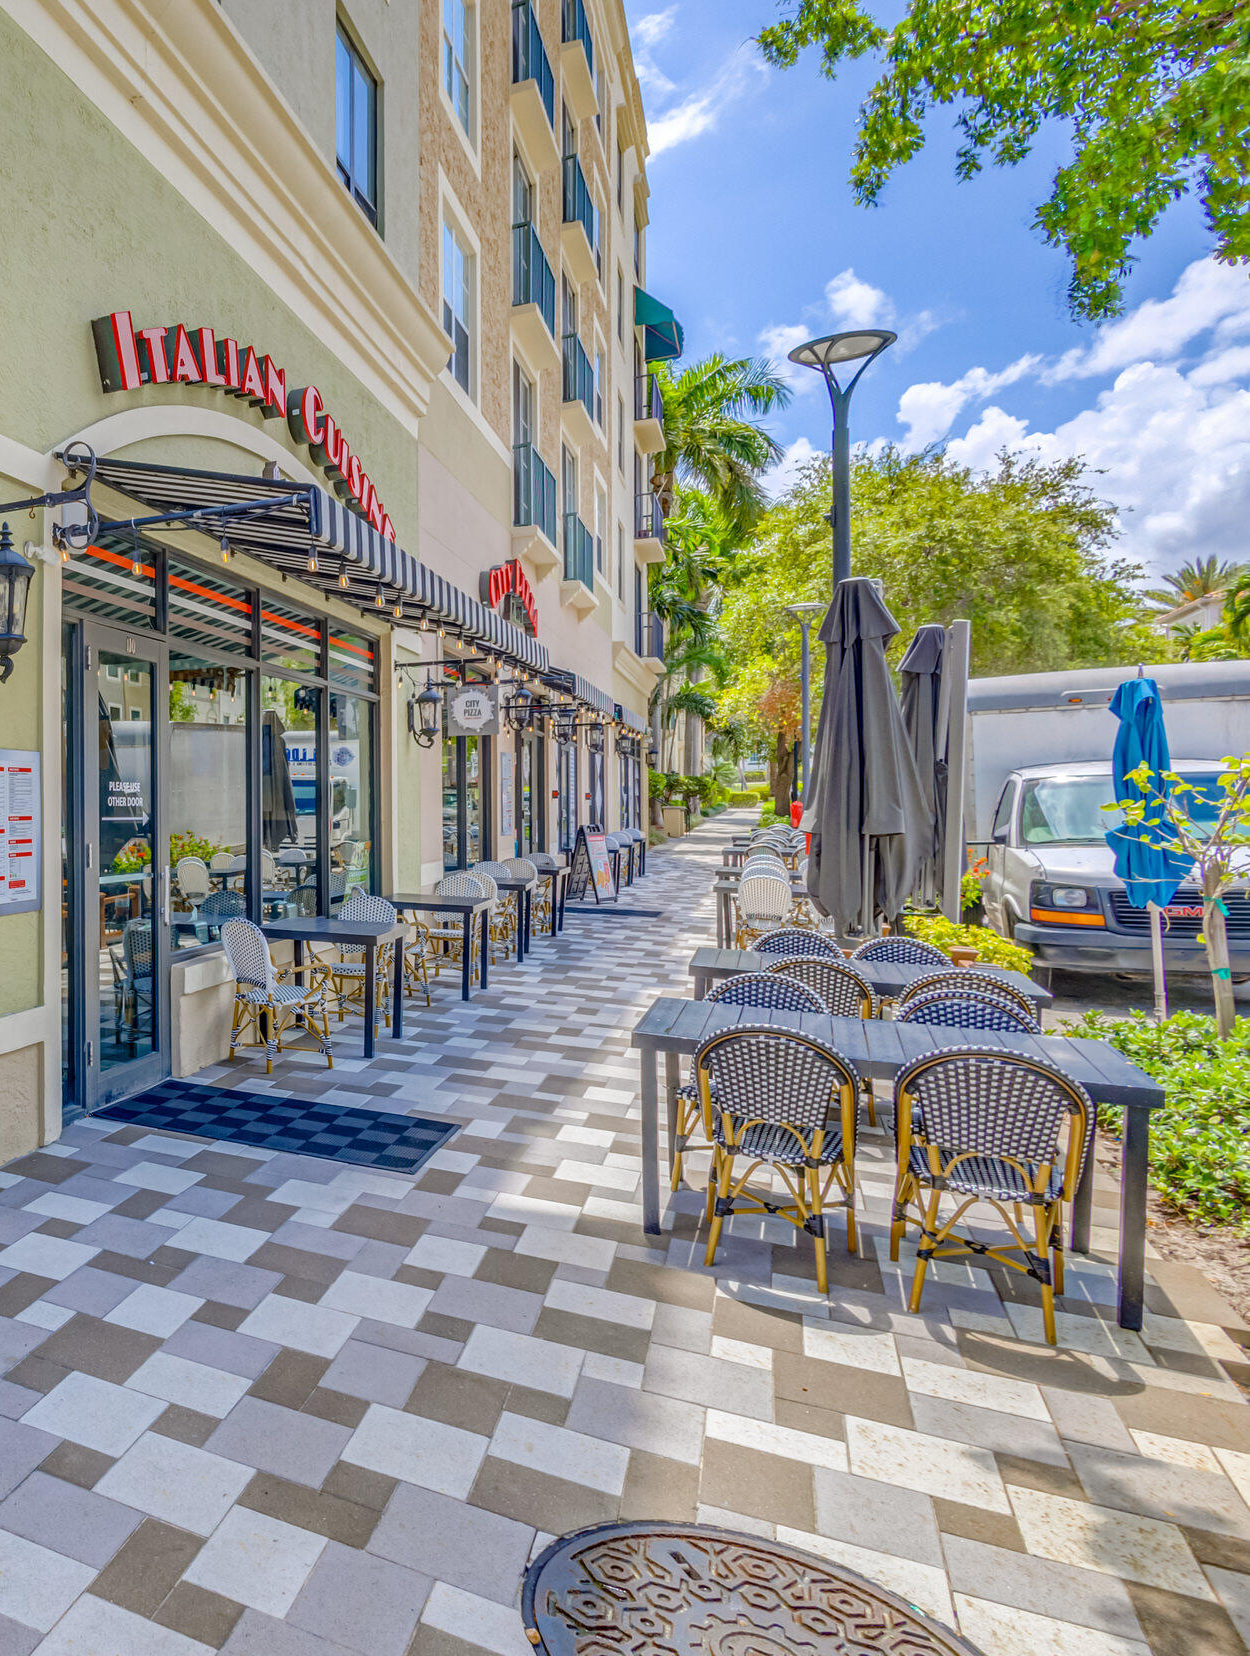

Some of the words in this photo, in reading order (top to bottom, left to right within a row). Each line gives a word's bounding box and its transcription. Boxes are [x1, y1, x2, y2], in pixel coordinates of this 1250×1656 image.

[109, 310, 286, 419] ITALIAN
[488, 563, 514, 609] CITY
[465, 699, 480, 708] CITY
[463, 708, 482, 717] PIZZA
[109, 781, 130, 791] PLEASE
[130, 782, 141, 792] USE
[107, 796, 127, 807] OTHER
[127, 797, 143, 807] DOOR
[1164, 905, 1204, 917] GM
